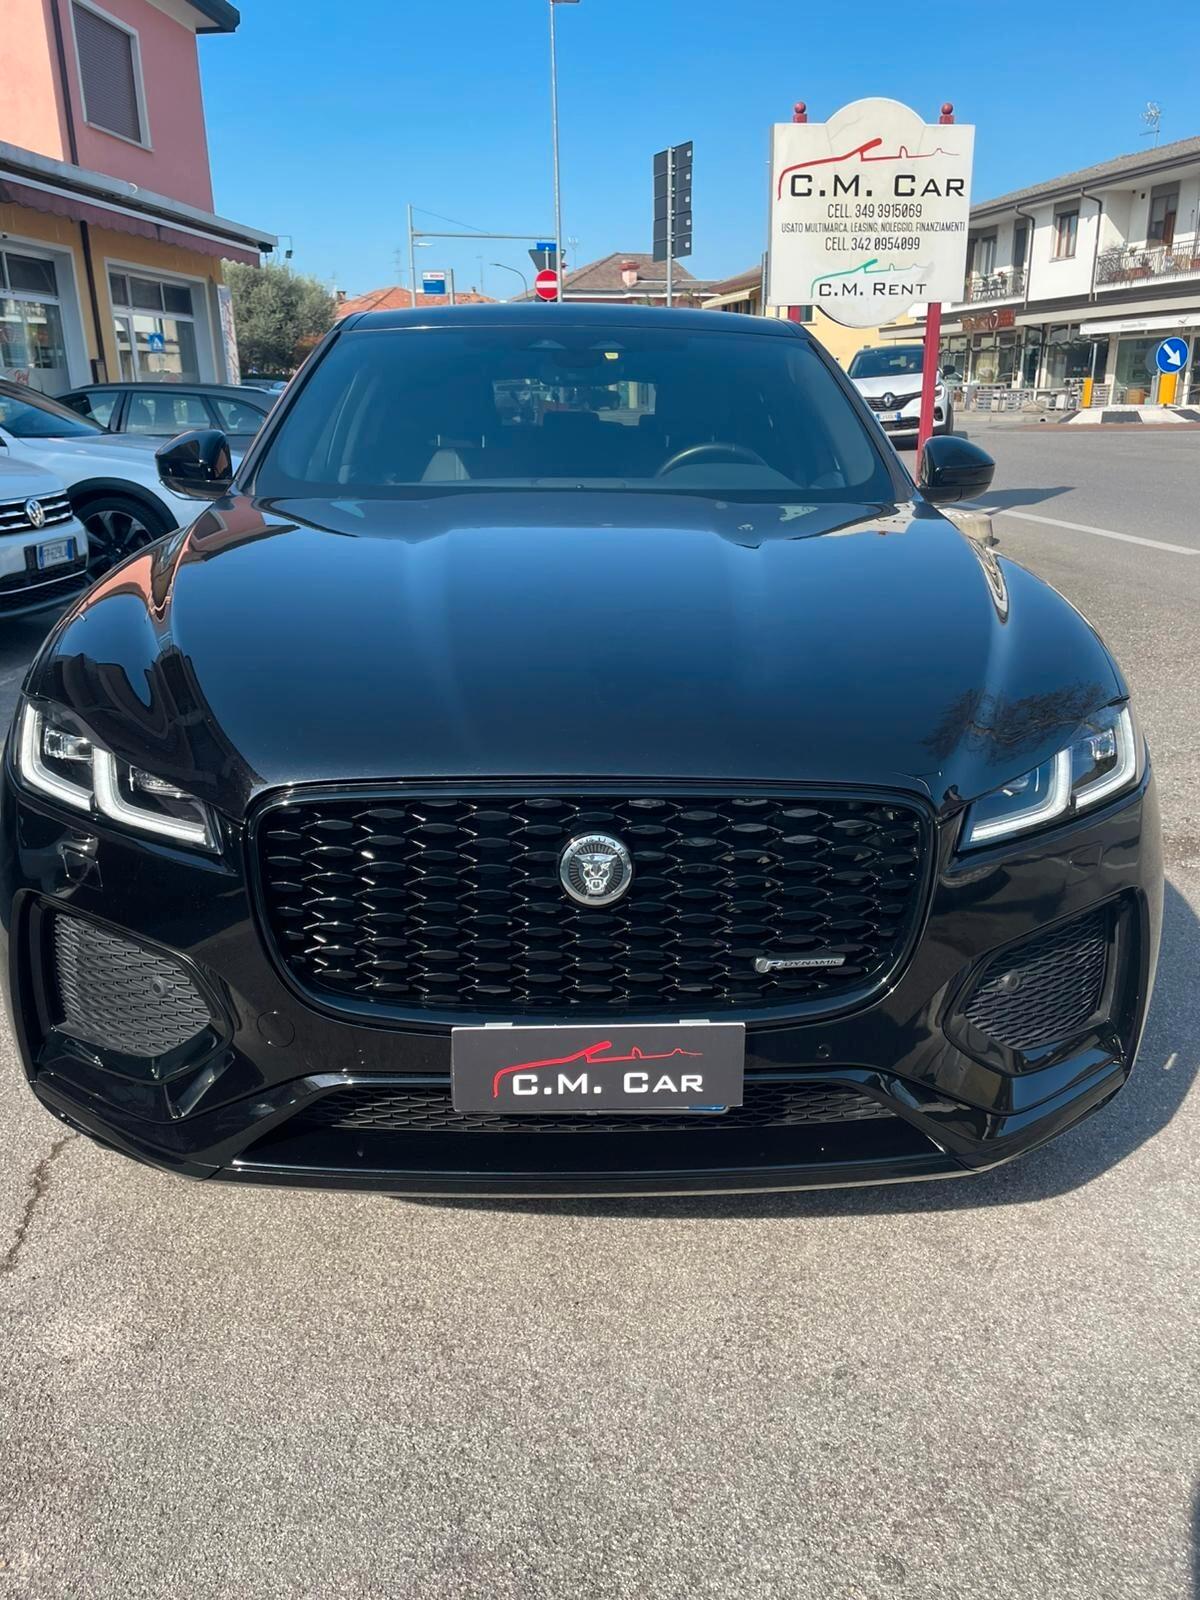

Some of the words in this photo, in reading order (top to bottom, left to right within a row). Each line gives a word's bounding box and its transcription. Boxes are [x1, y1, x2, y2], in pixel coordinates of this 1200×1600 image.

[790, 174, 873, 197] C.M.
[827, 204, 852, 218] CELL.
[855, 204, 876, 218] 349
[877, 204, 922, 218] 3915069
[781, 223, 803, 233] USATO
[850, 223, 879, 233] LEASING,
[881, 222, 914, 232] NOLEGGIO,
[915, 222, 965, 232] FINANZIAMENTI
[825, 238, 850, 251] CELL.
[851, 238, 871, 251] 342
[874, 237, 920, 250] 0954099
[818, 283, 864, 297] C.M.
[512, 1074, 602, 1096] C.M.
